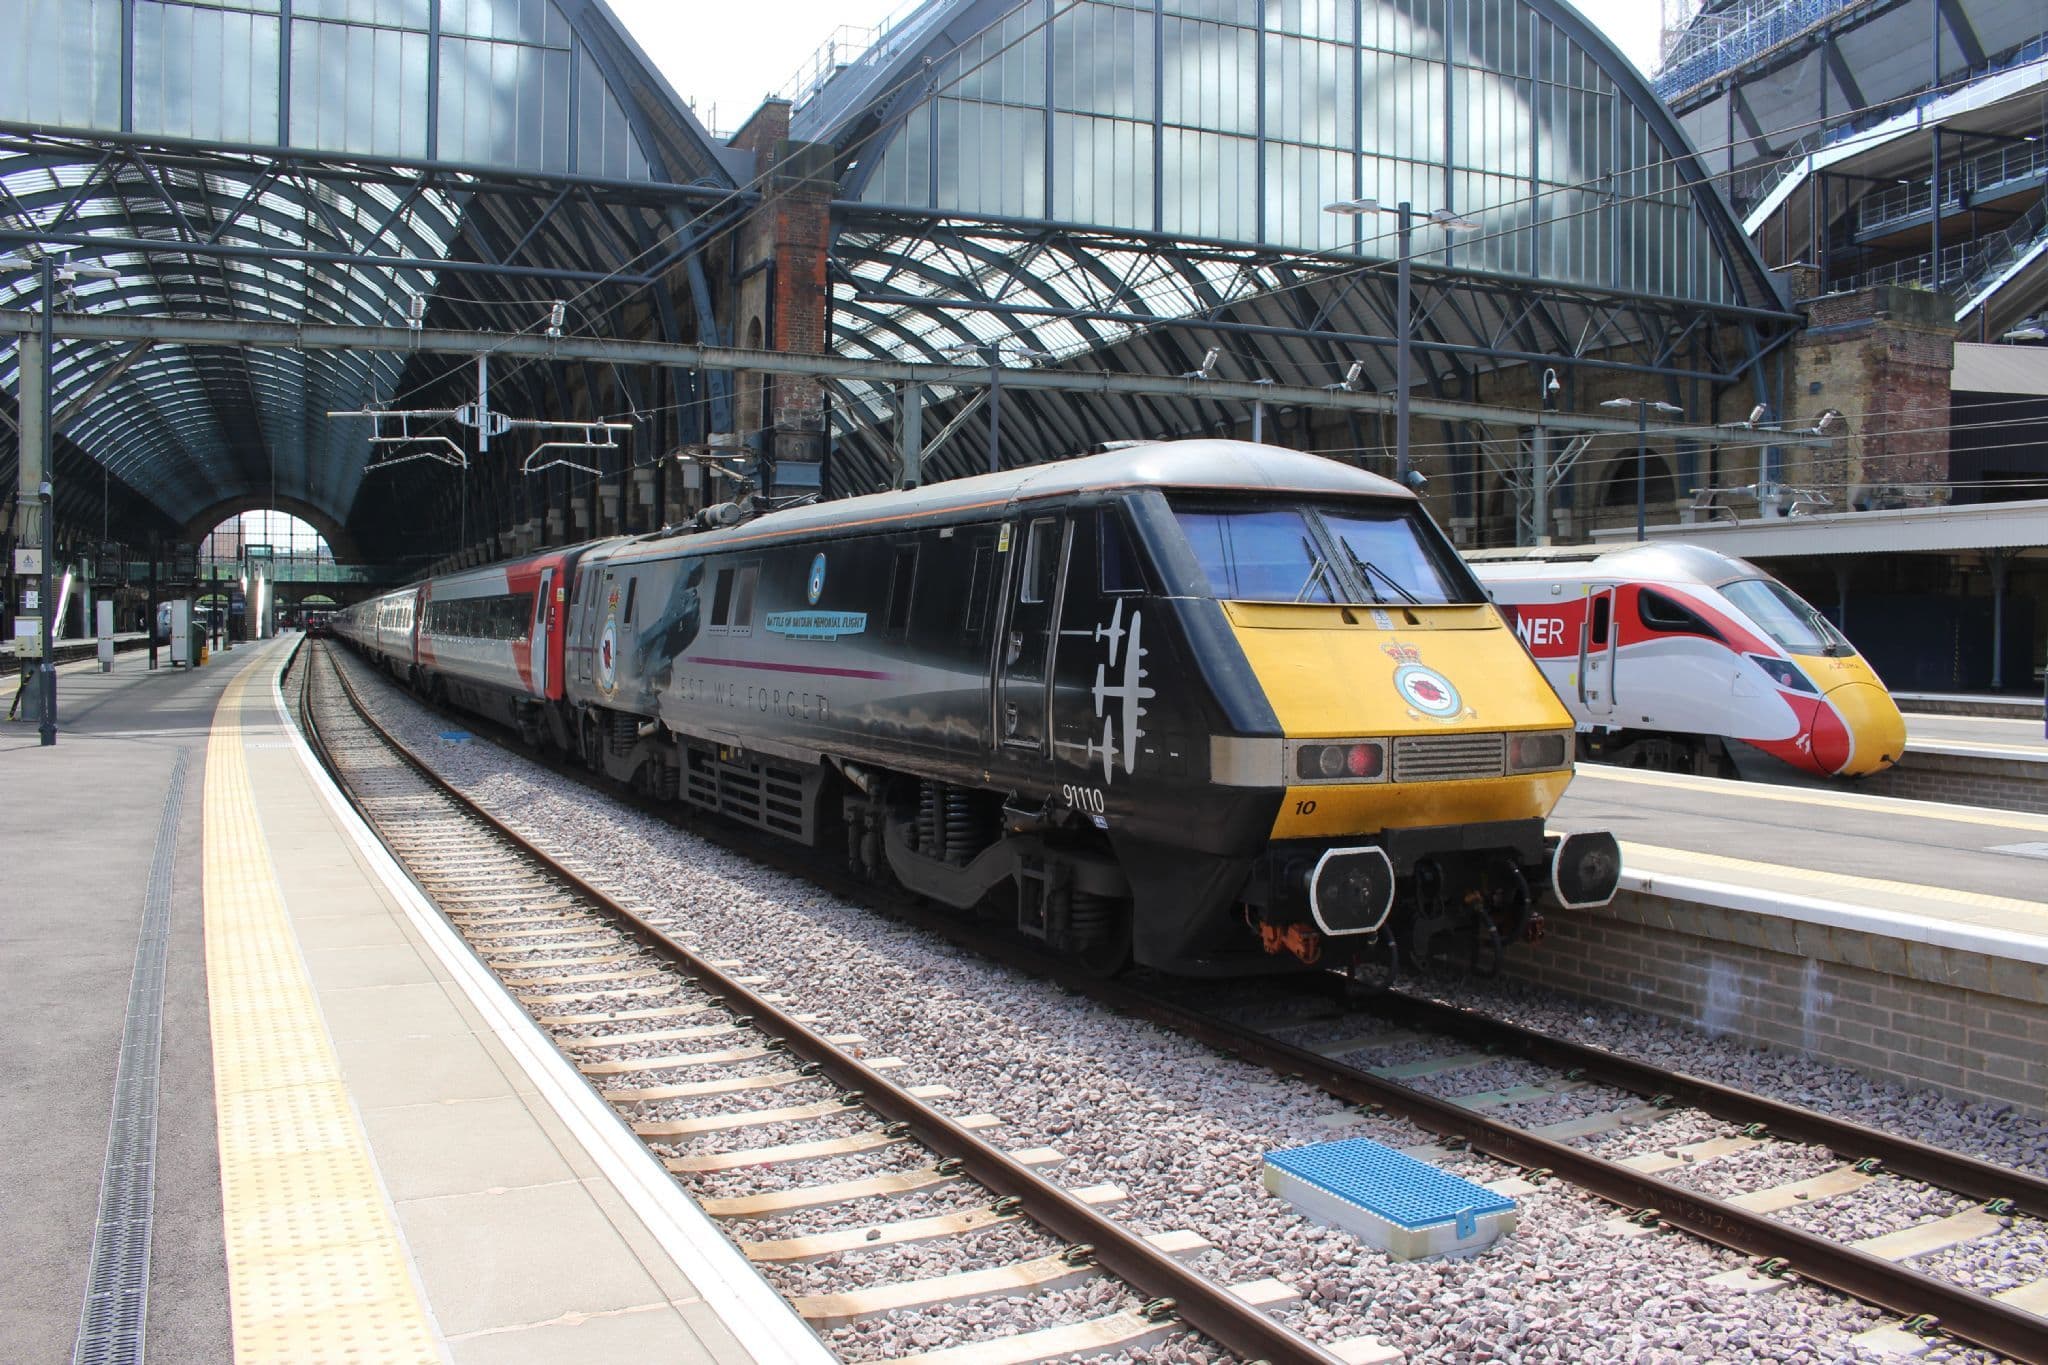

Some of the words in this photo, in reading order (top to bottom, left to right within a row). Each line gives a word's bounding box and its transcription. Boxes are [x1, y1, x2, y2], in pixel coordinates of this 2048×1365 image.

[714, 681, 735, 708] WE
[748, 686, 825, 720] FORGET
[1063, 784, 1104, 814] 91110
[1295, 800, 1317, 816] 10
